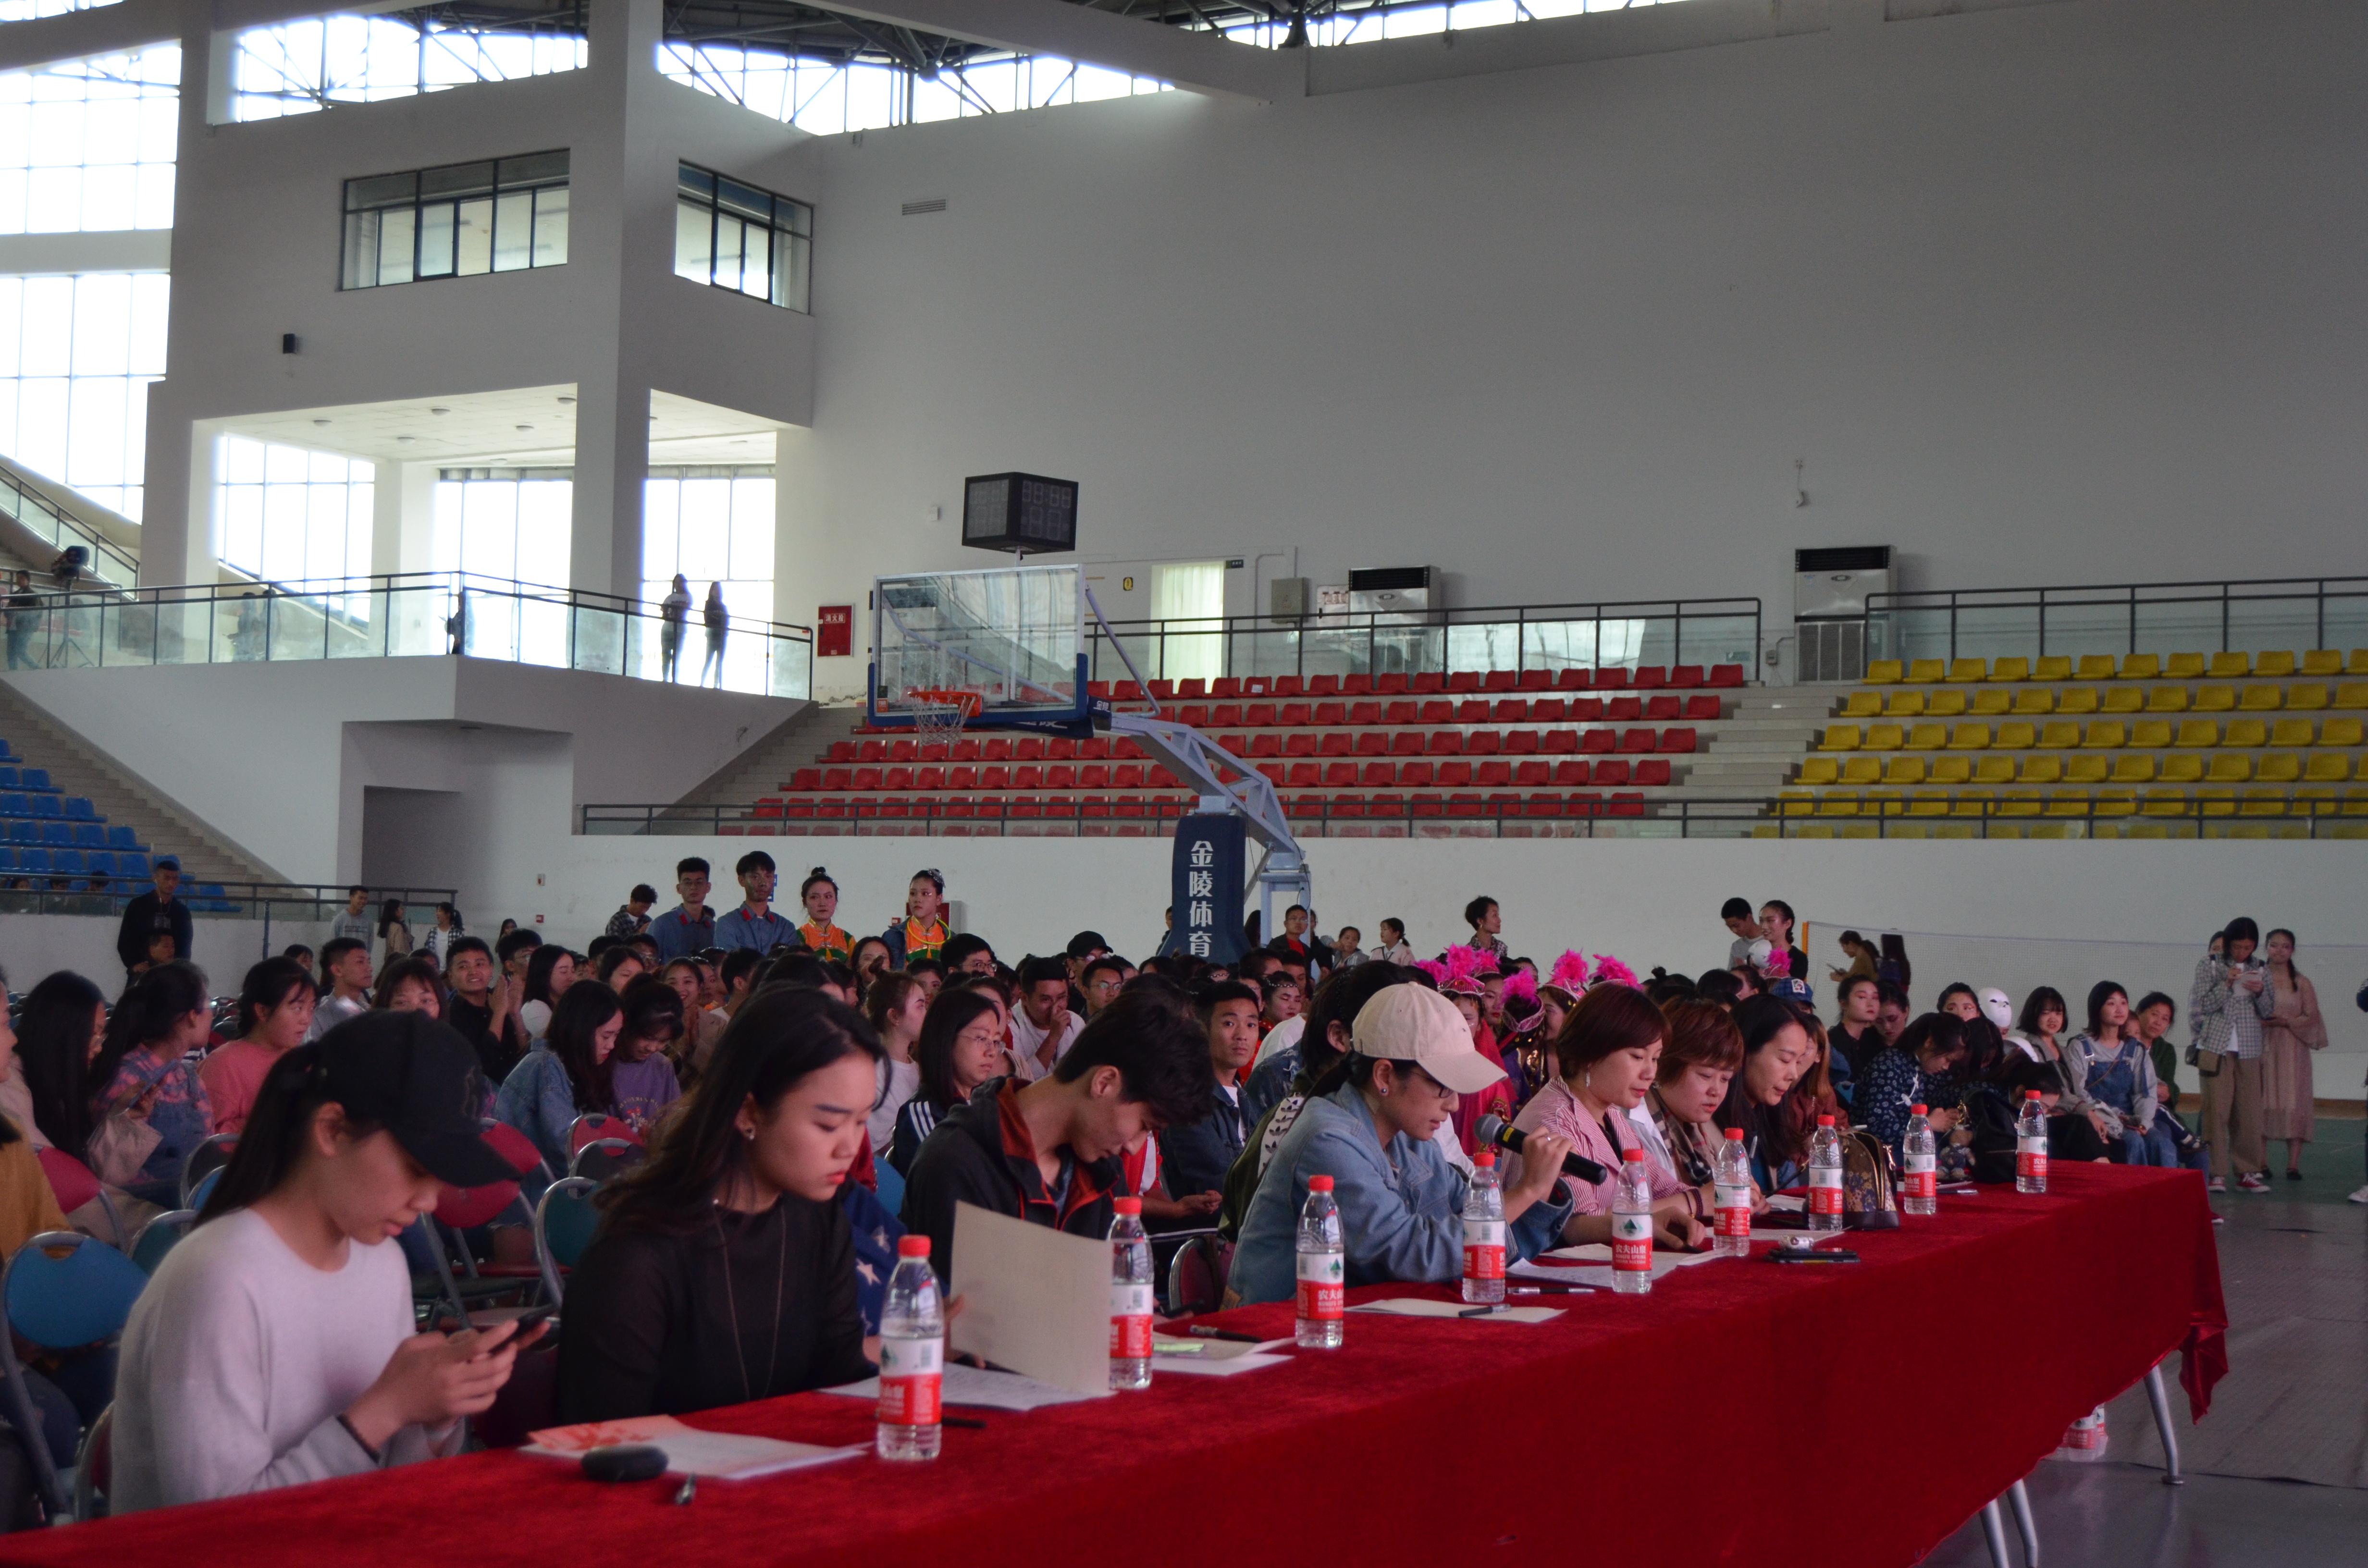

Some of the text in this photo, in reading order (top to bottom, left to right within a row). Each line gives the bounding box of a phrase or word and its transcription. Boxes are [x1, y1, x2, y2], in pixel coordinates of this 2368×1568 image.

[826, 614, 844, 623] 消火栓
[1188, 840, 1214, 957] 金陵体育
[1615, 1243, 1647, 1254] 农夫山泉
